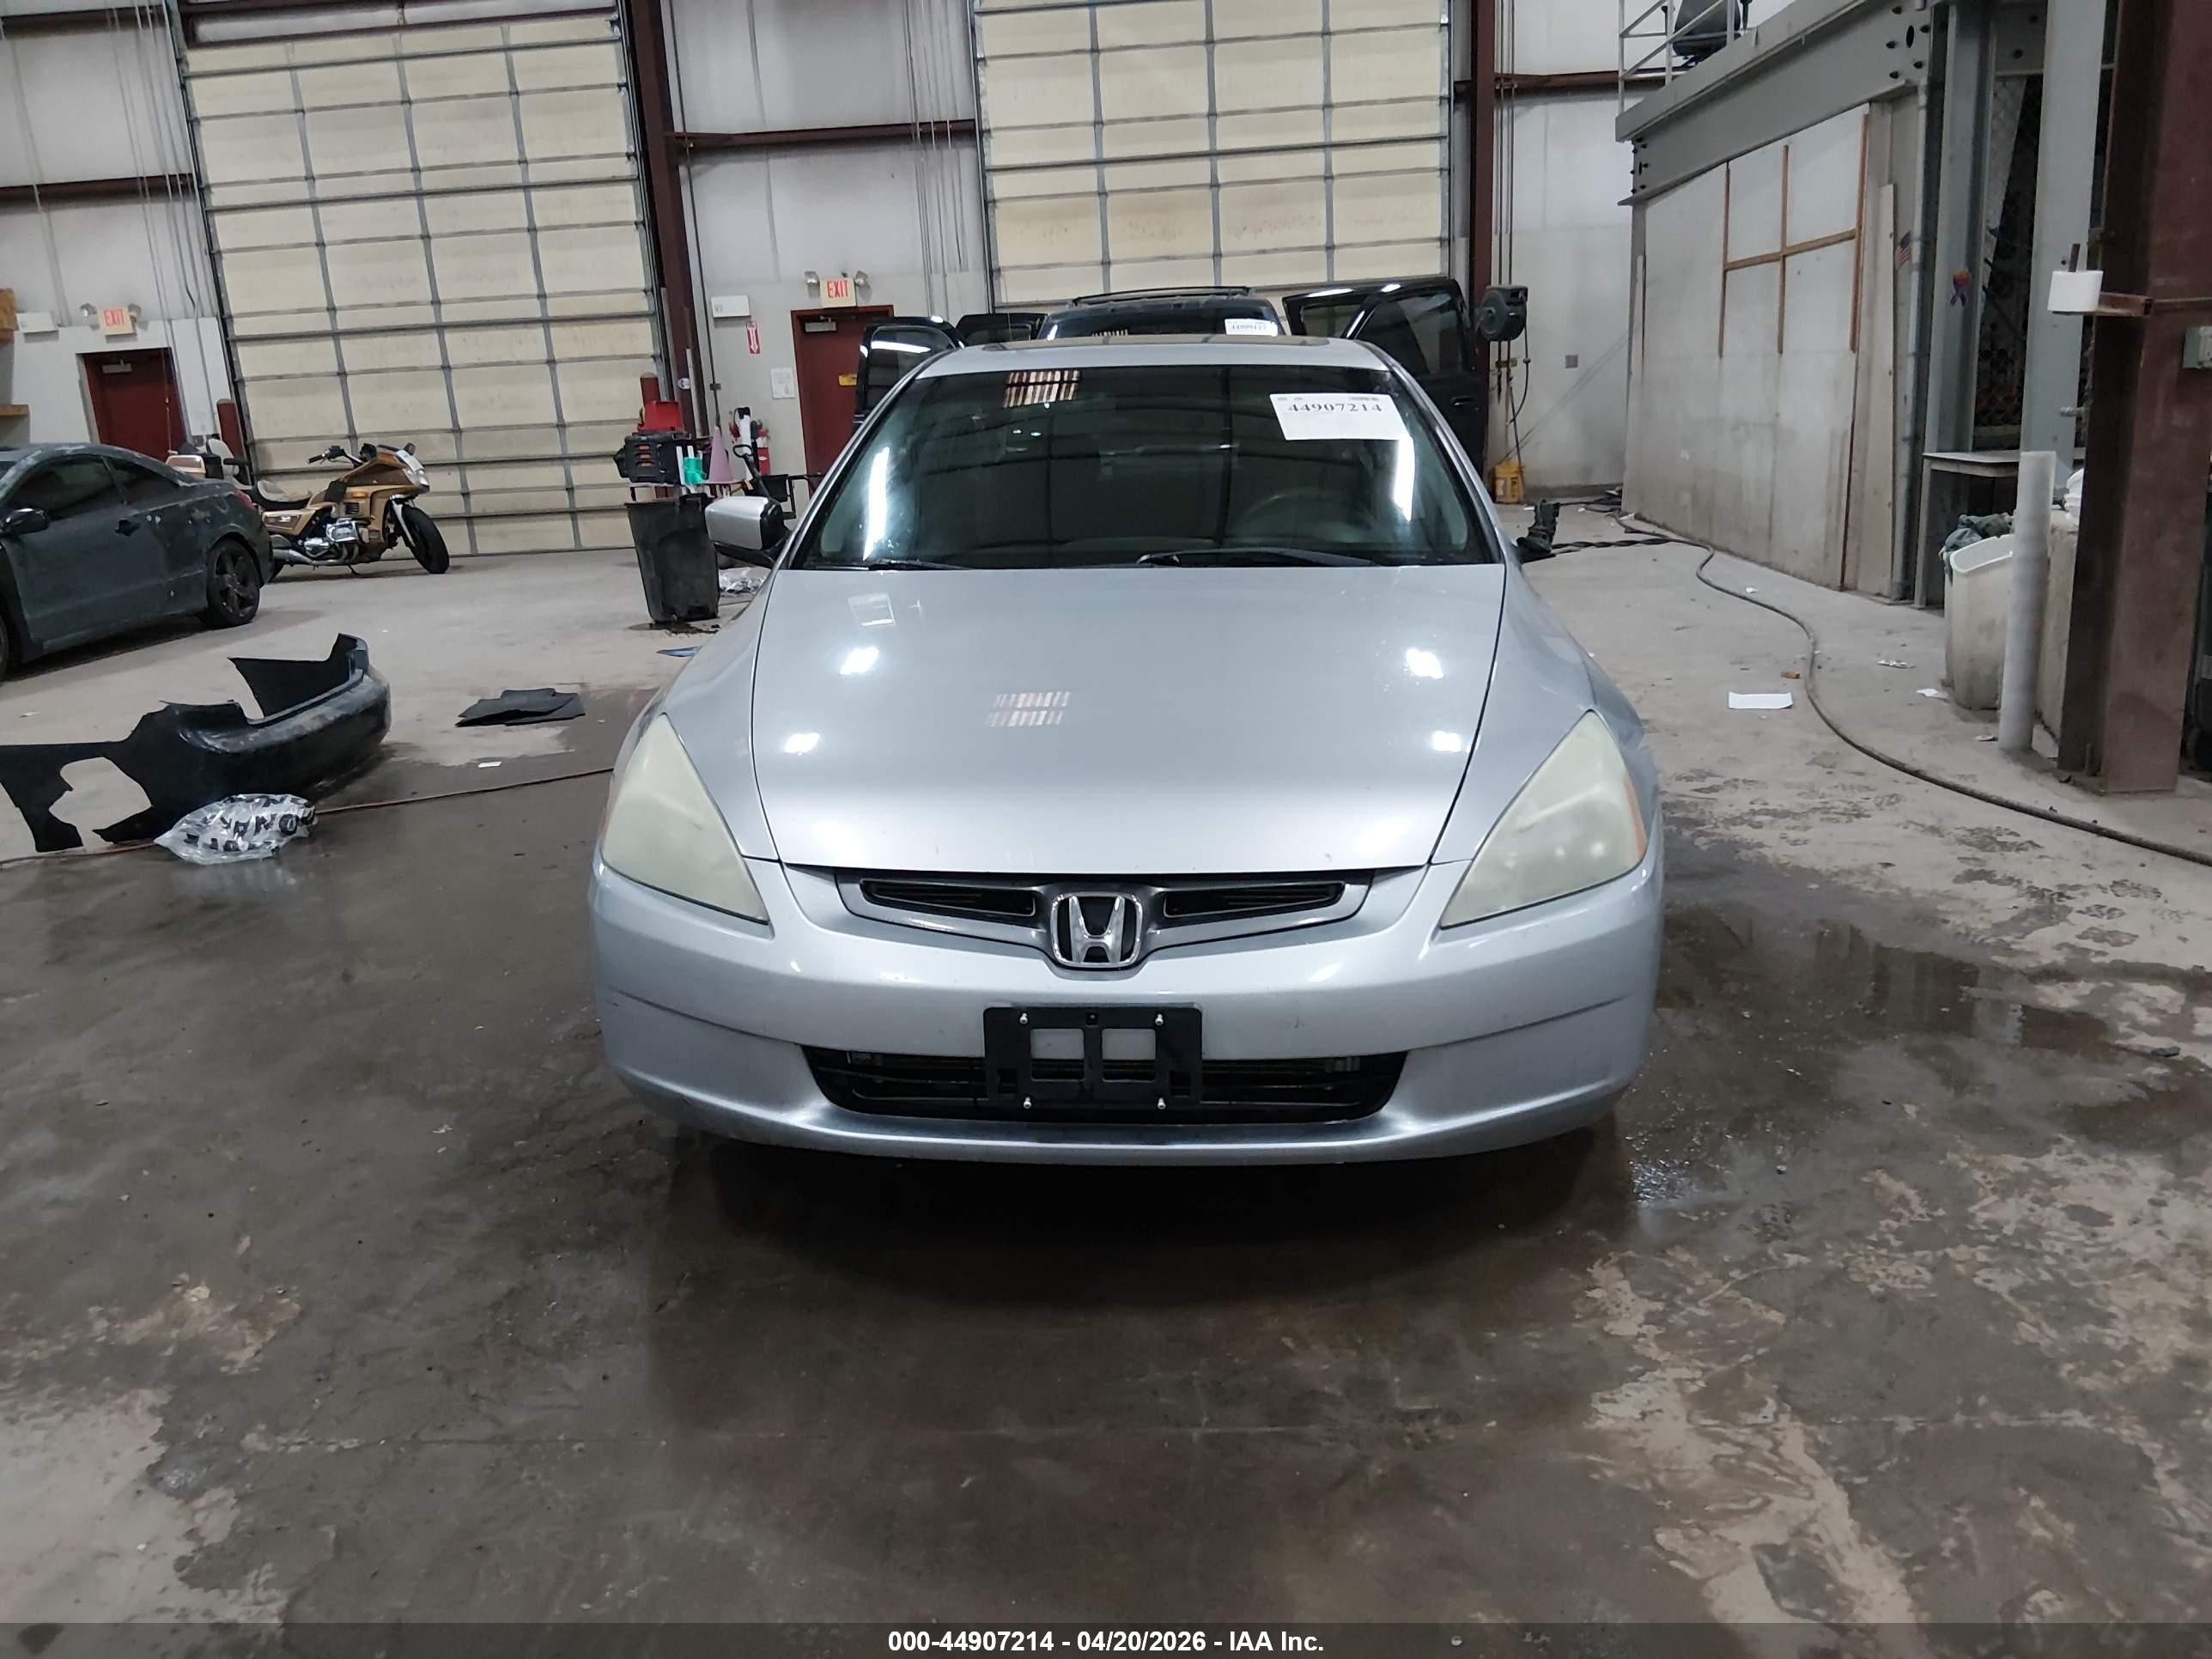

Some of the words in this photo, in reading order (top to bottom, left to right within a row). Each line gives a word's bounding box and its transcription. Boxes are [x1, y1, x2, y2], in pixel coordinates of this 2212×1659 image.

[826, 279, 849, 299] EXIT
[103, 308, 125, 326] EXIT
[1288, 403, 1383, 412] 44907214
